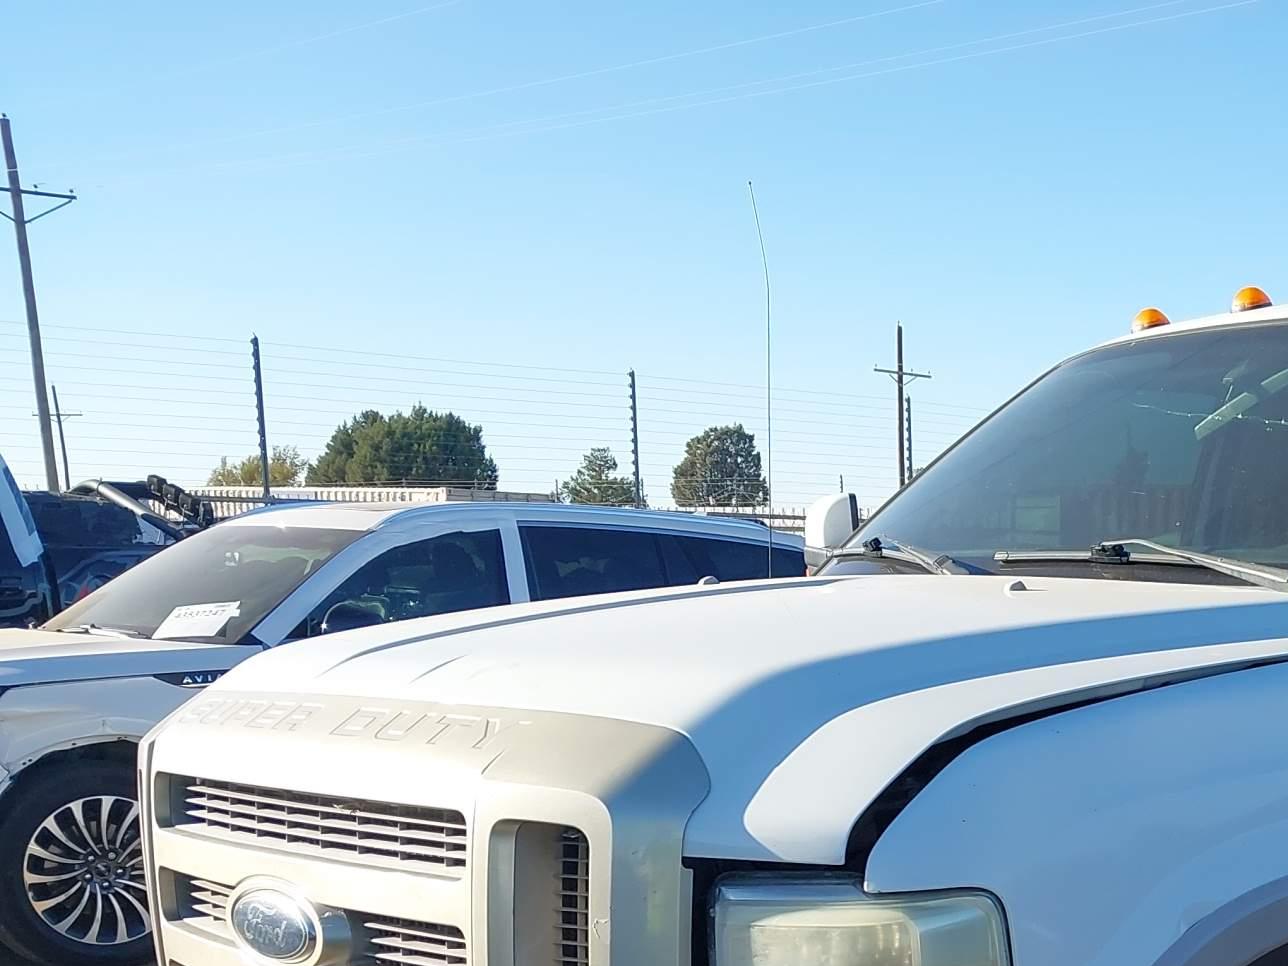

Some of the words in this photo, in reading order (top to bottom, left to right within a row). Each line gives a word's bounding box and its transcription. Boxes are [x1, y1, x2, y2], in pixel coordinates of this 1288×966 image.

[179, 699, 325, 732] SUPER
[330, 707, 531, 749] DUTY
[243, 902, 287, 948] Ford
